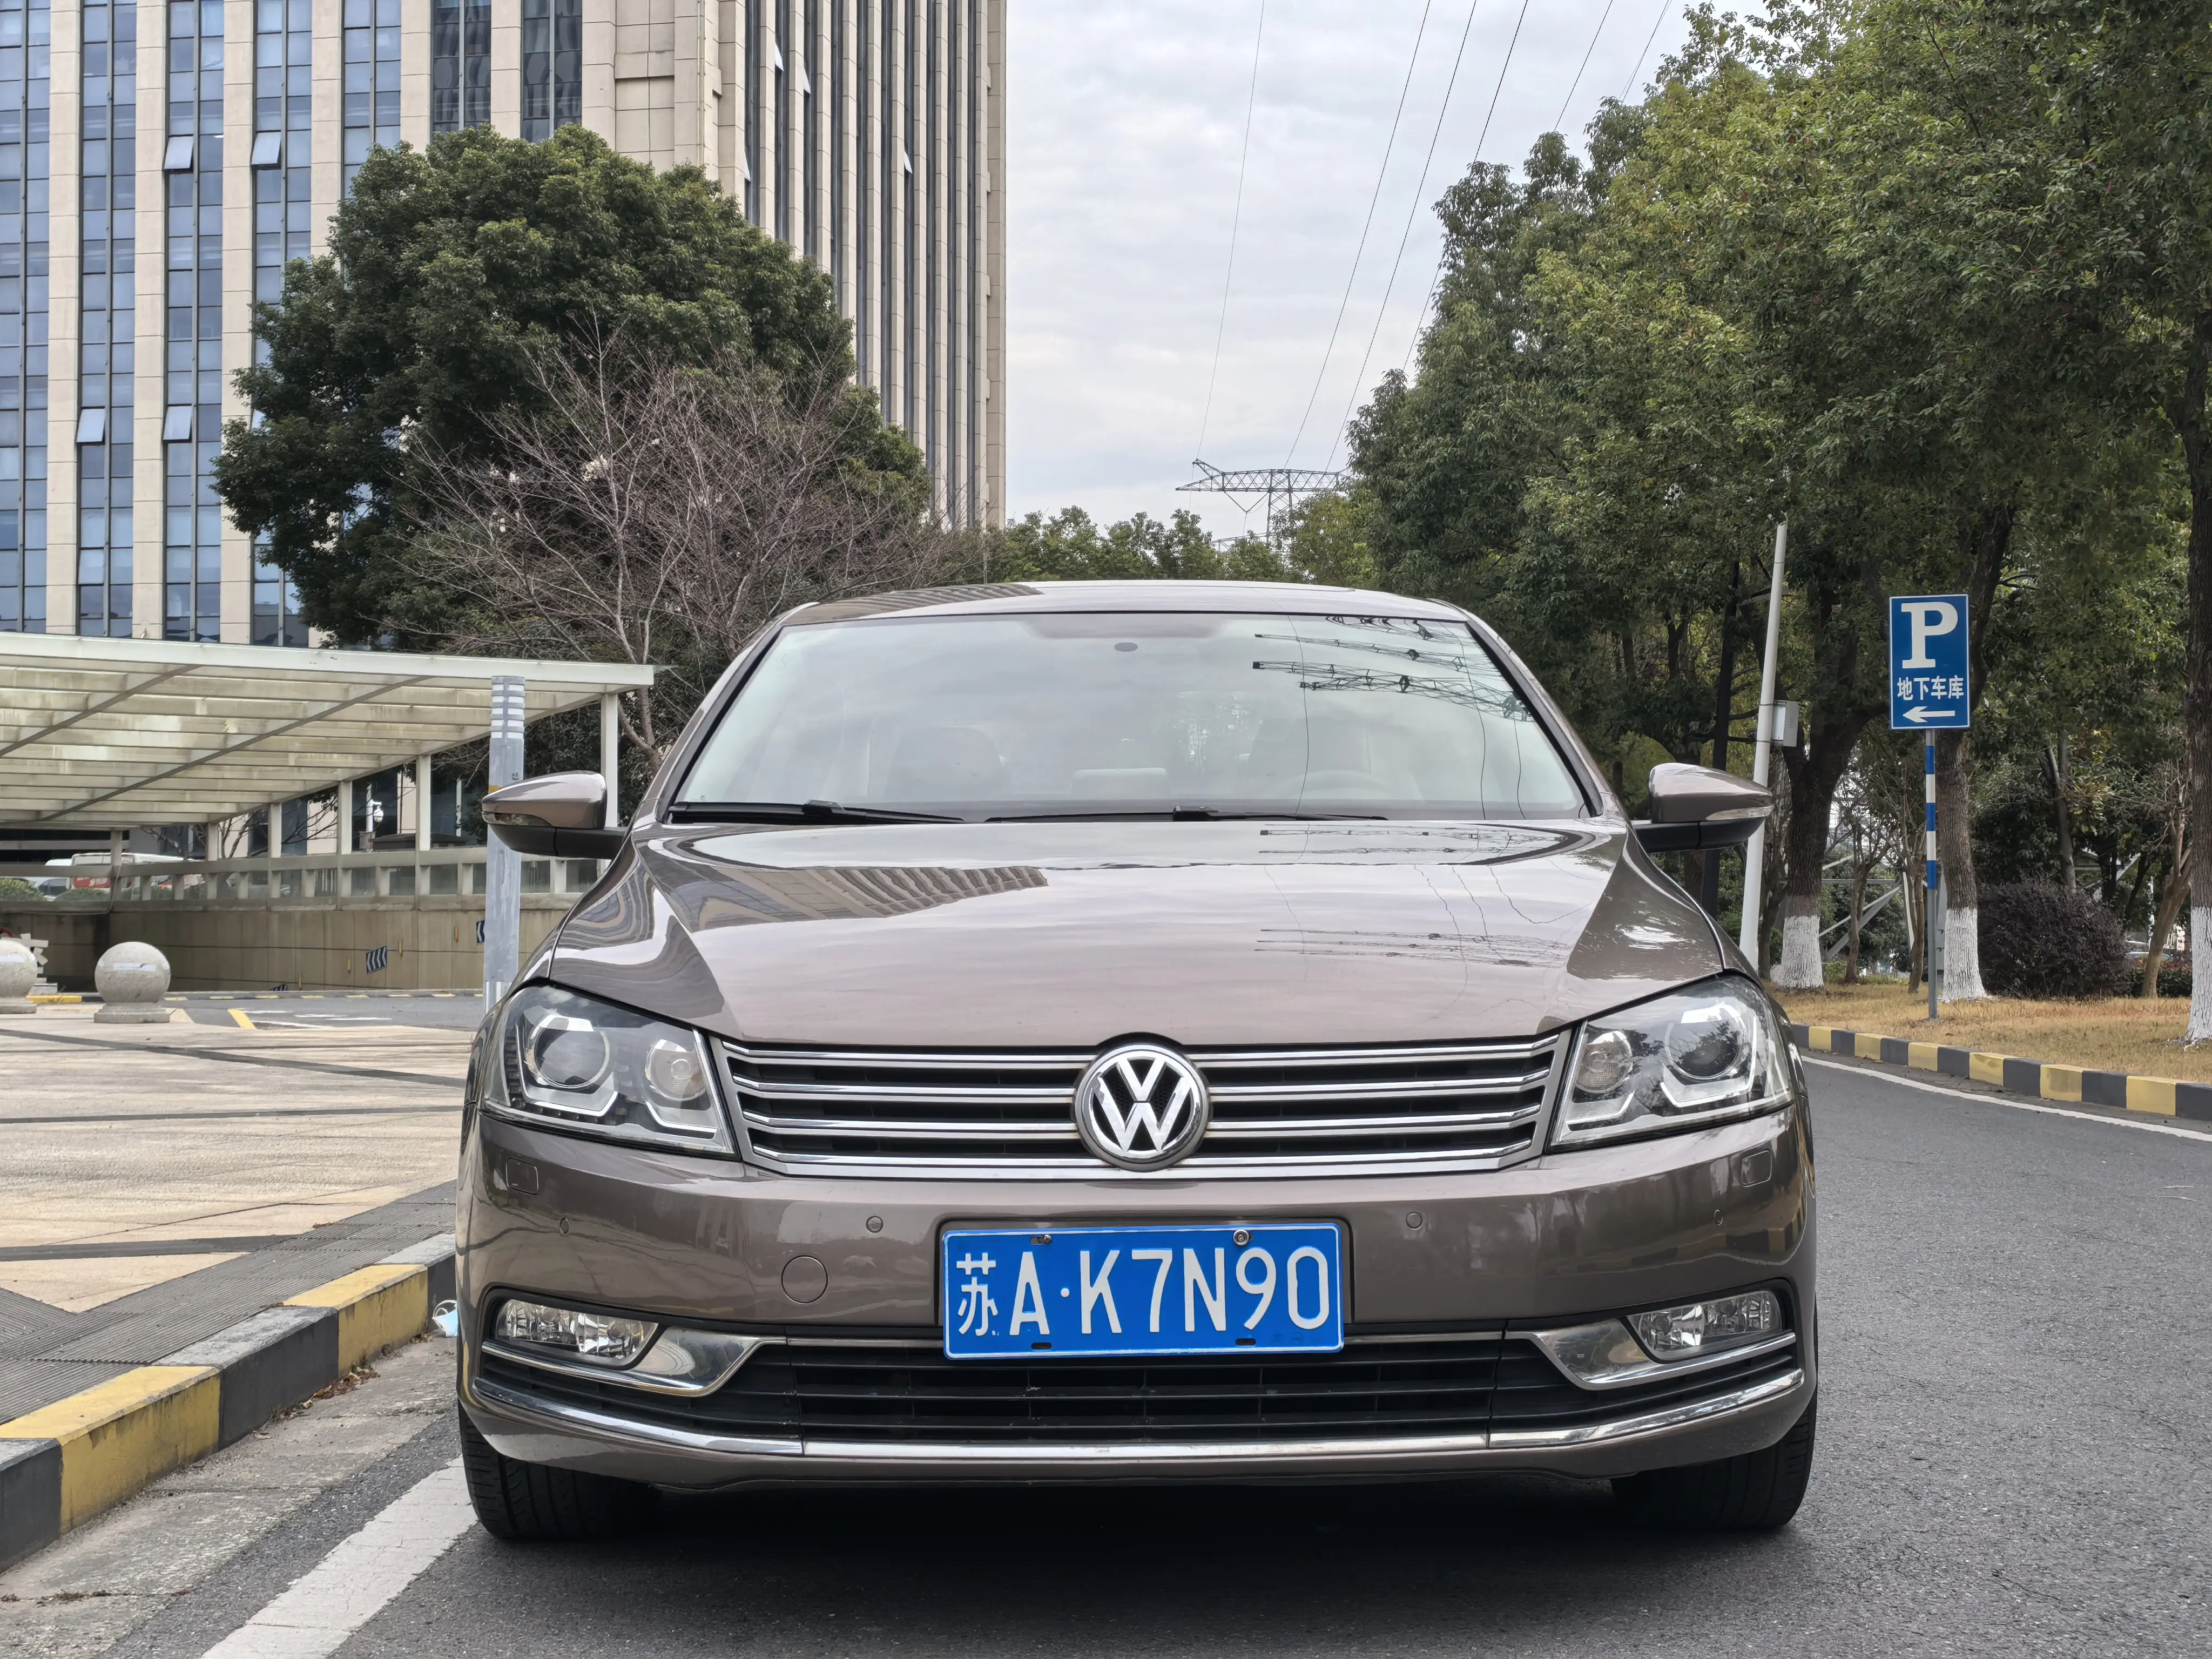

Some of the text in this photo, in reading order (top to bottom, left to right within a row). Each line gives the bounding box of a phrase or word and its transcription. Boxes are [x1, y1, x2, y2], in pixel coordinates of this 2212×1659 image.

[1901, 602, 1958, 669] P
[1897, 675, 1964, 700] 地下车库
